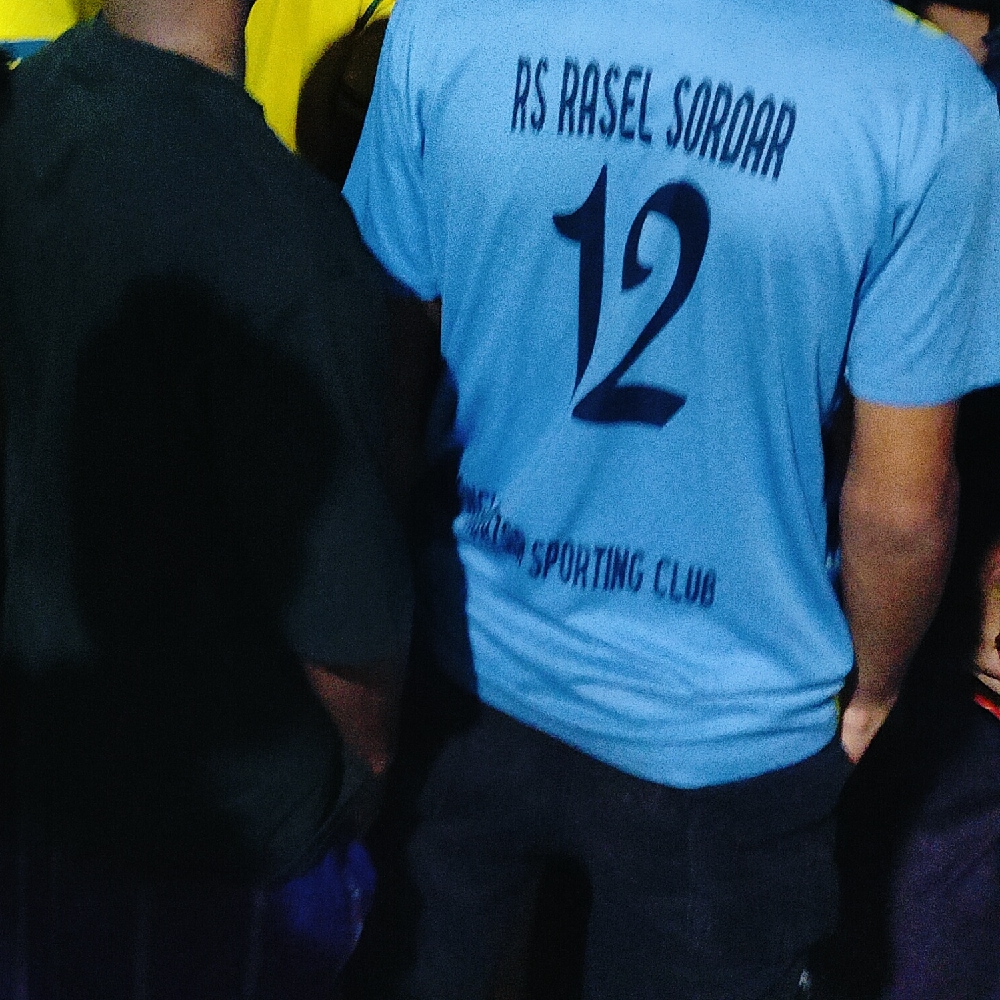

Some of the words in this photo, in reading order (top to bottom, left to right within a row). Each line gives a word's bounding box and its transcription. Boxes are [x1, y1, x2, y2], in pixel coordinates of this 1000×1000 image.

[511, 56, 548, 132] RS
[557, 56, 653, 144] RASEL
[666, 75, 797, 179] SORDAR
[552, 163, 711, 427] 12
[529, 538, 644, 593] SPORTING
[653, 556, 717, 608] CLUB
